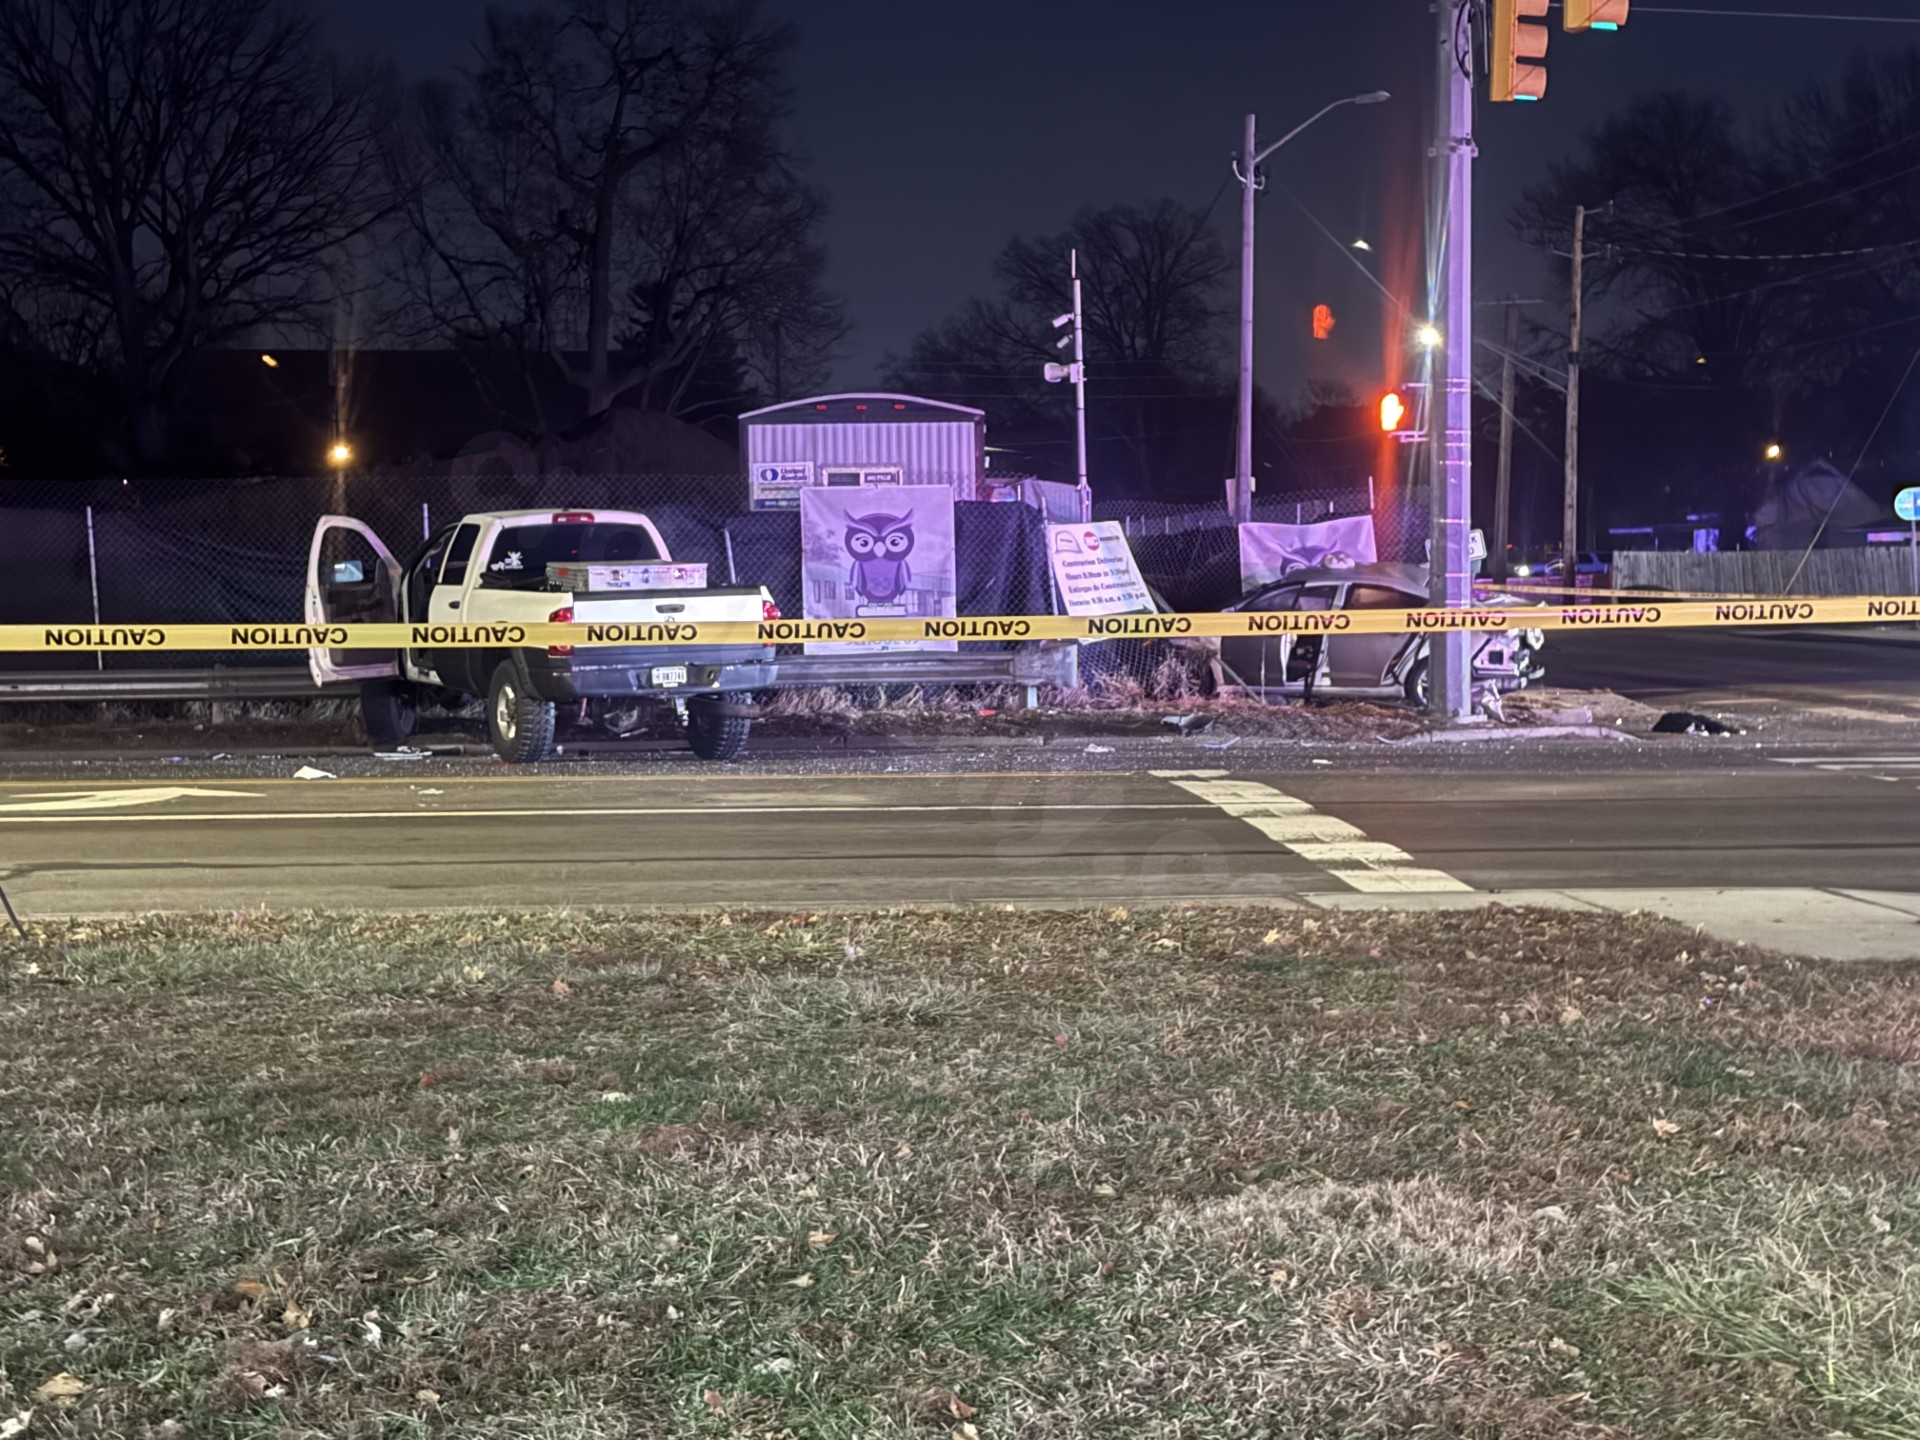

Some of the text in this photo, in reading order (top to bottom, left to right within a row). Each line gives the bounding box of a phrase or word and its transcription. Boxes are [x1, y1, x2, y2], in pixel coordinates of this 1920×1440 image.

[780, 467, 806, 475] United
[44, 600, 1920, 646] TION CAUTION CAUTION CAUTION CAUTION CAUTION CAUTION CAUTION CAUTION CAUTION CAUTION CAUTION
